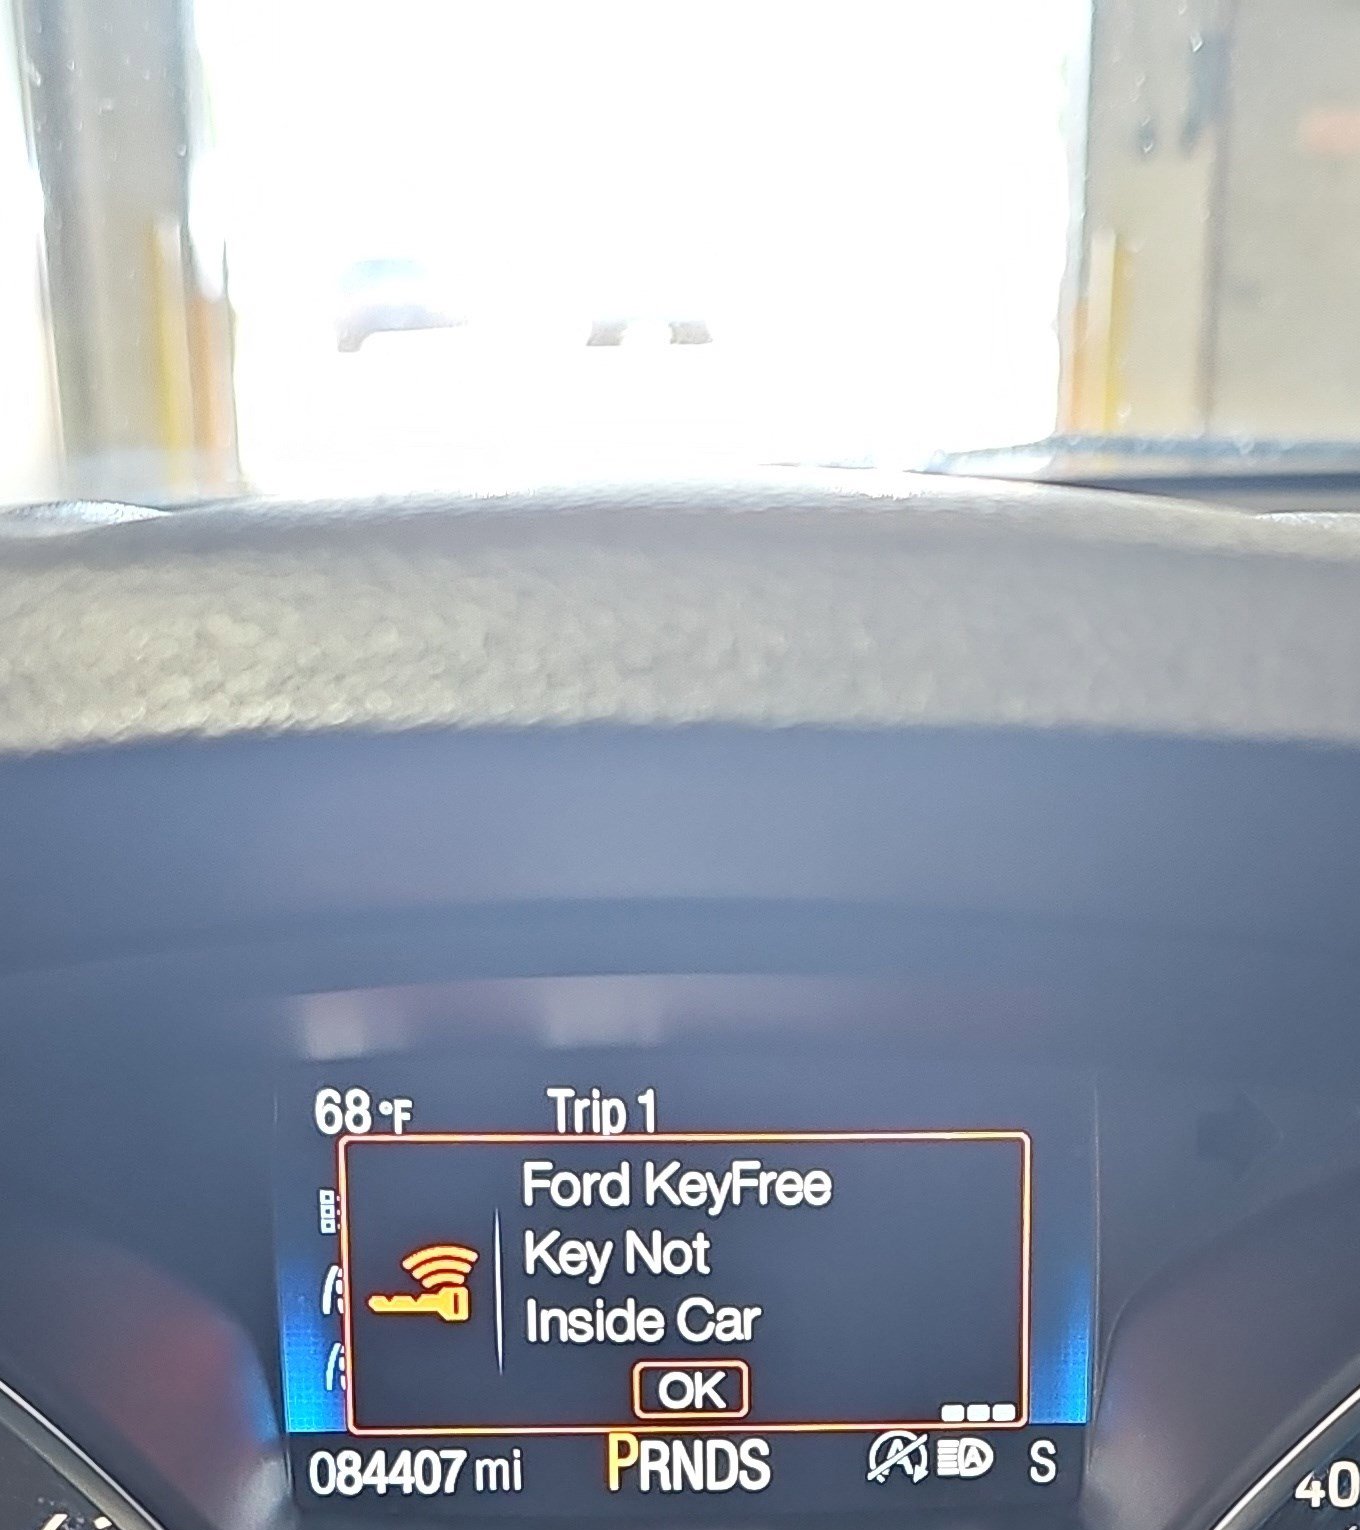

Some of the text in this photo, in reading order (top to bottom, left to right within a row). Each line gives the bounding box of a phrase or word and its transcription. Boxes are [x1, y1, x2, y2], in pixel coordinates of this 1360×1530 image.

[547, 1088, 655, 1135] Trip 1
[523, 1160, 833, 1216] Ford KeyFree
[524, 1230, 711, 1283] Key Not
[526, 1296, 762, 1343] Inside Car
[658, 1372, 727, 1410] OK
[309, 1448, 522, 1496] 084407 mi
[1030, 1439, 1057, 1483] S
[1294, 1460, 1360, 1508] 40
